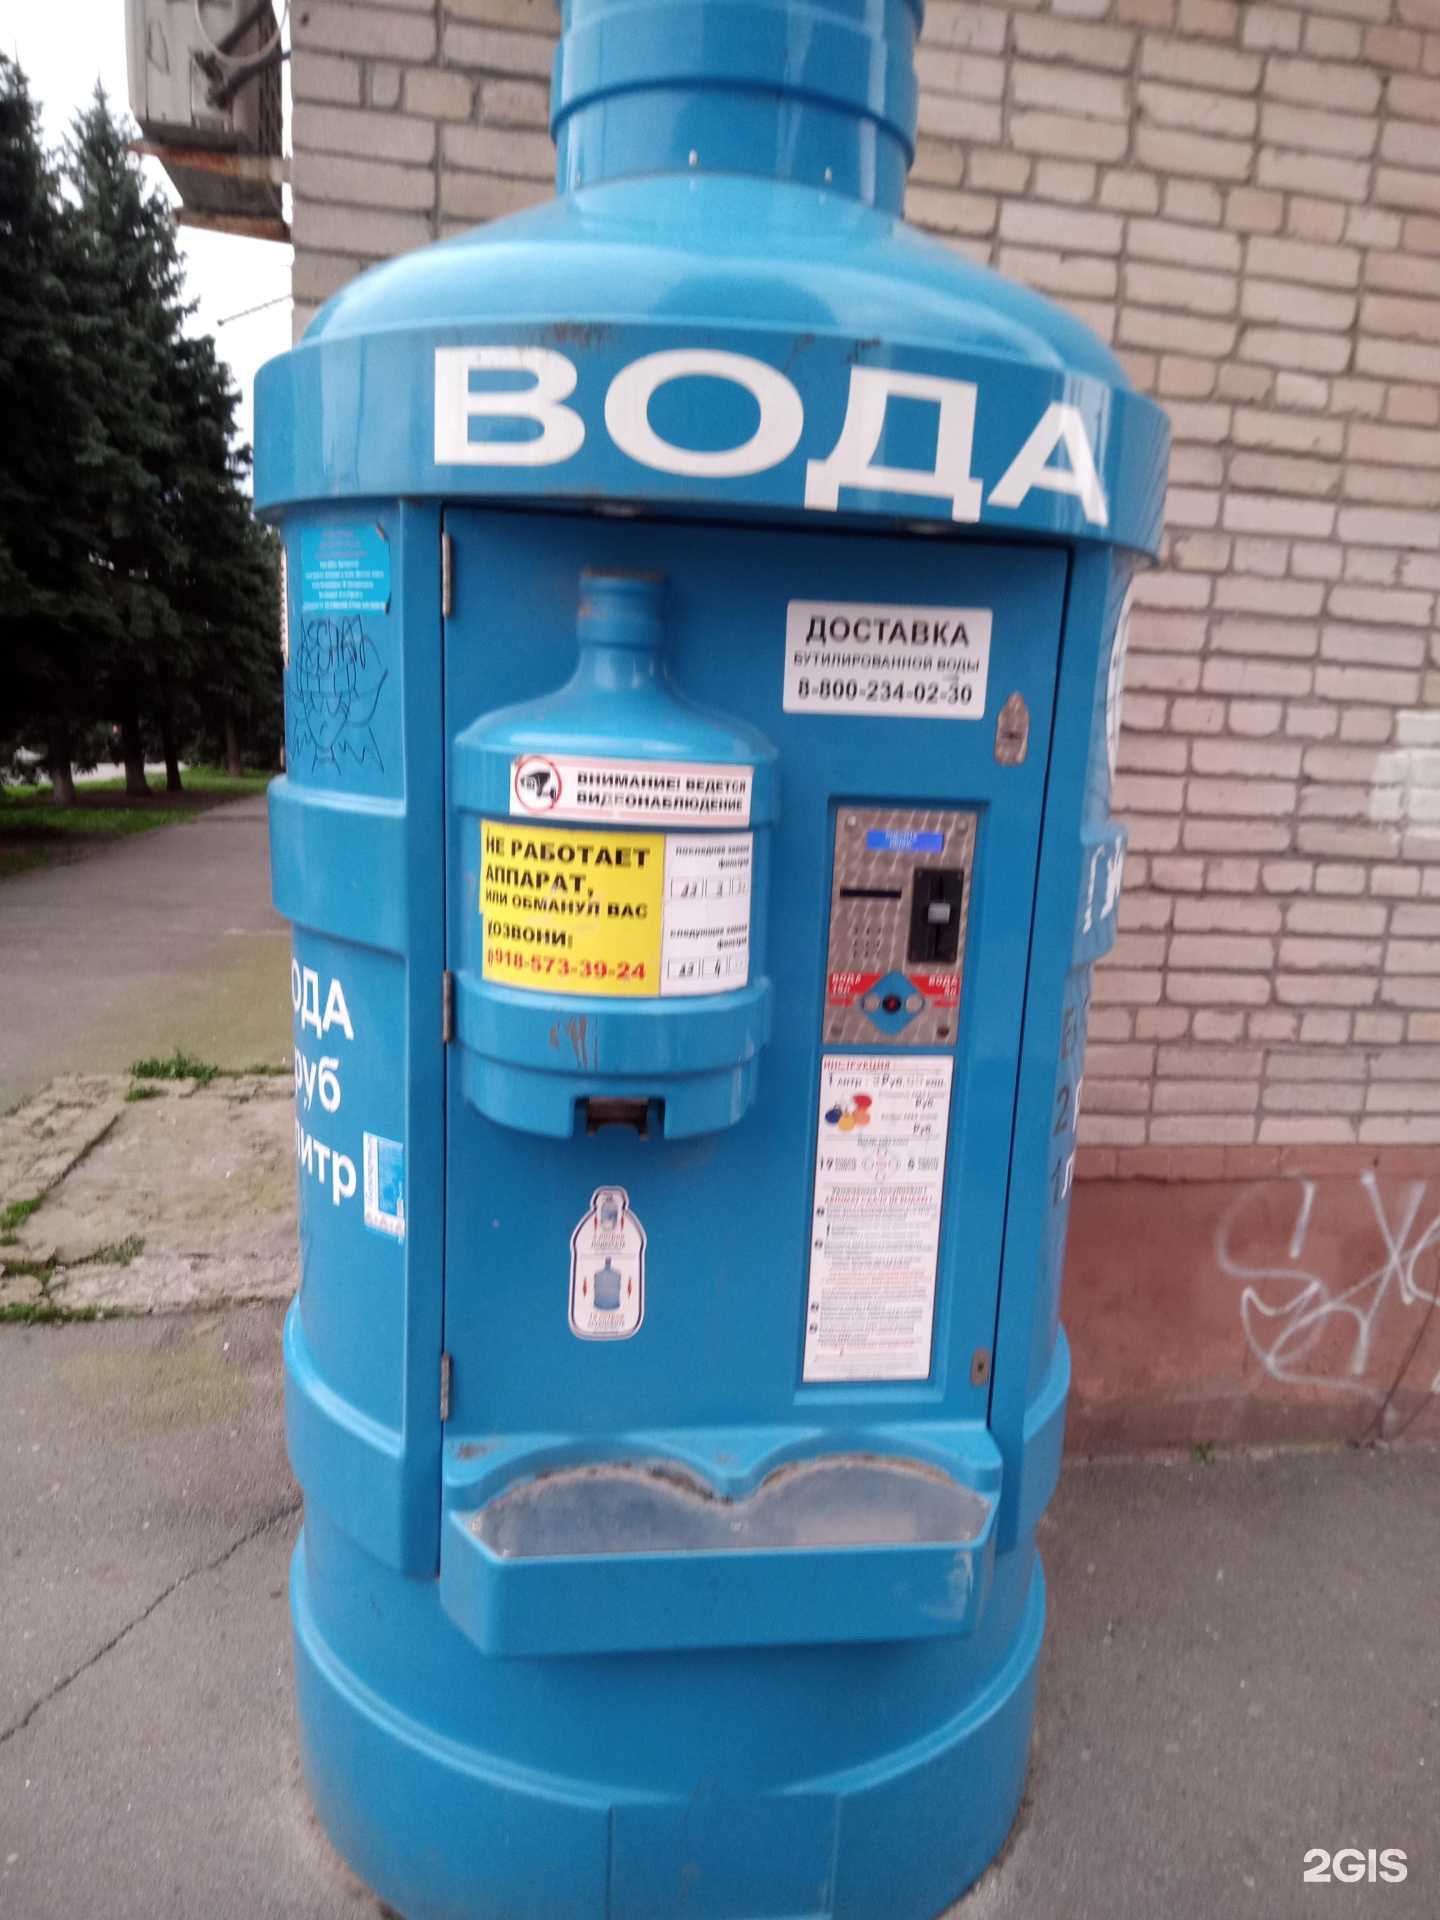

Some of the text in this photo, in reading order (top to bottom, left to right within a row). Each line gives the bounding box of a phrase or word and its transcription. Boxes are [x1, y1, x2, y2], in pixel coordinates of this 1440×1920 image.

[434, 346, 1109, 528] ВОДА
[805, 615, 970, 648] ДОСТАВКА
[793, 650, 980, 675] БУТИЛИРОВАННОЙ ВОДЫ
[798, 676, 973, 706] 8-800-234-02-30
[577, 770, 747, 794] ВНИМАНИЕ! ВЕДЕТСЯ
[576, 790, 744, 814] ВИДЕОНАБЛЮДЕНИЕ
[486, 833, 650, 868] НЕ РАБОТАЕТ
[486, 863, 595, 897] АППАРАТ,
[485, 889, 649, 921] ИЛИ ОБМАНУЛ ВАС
